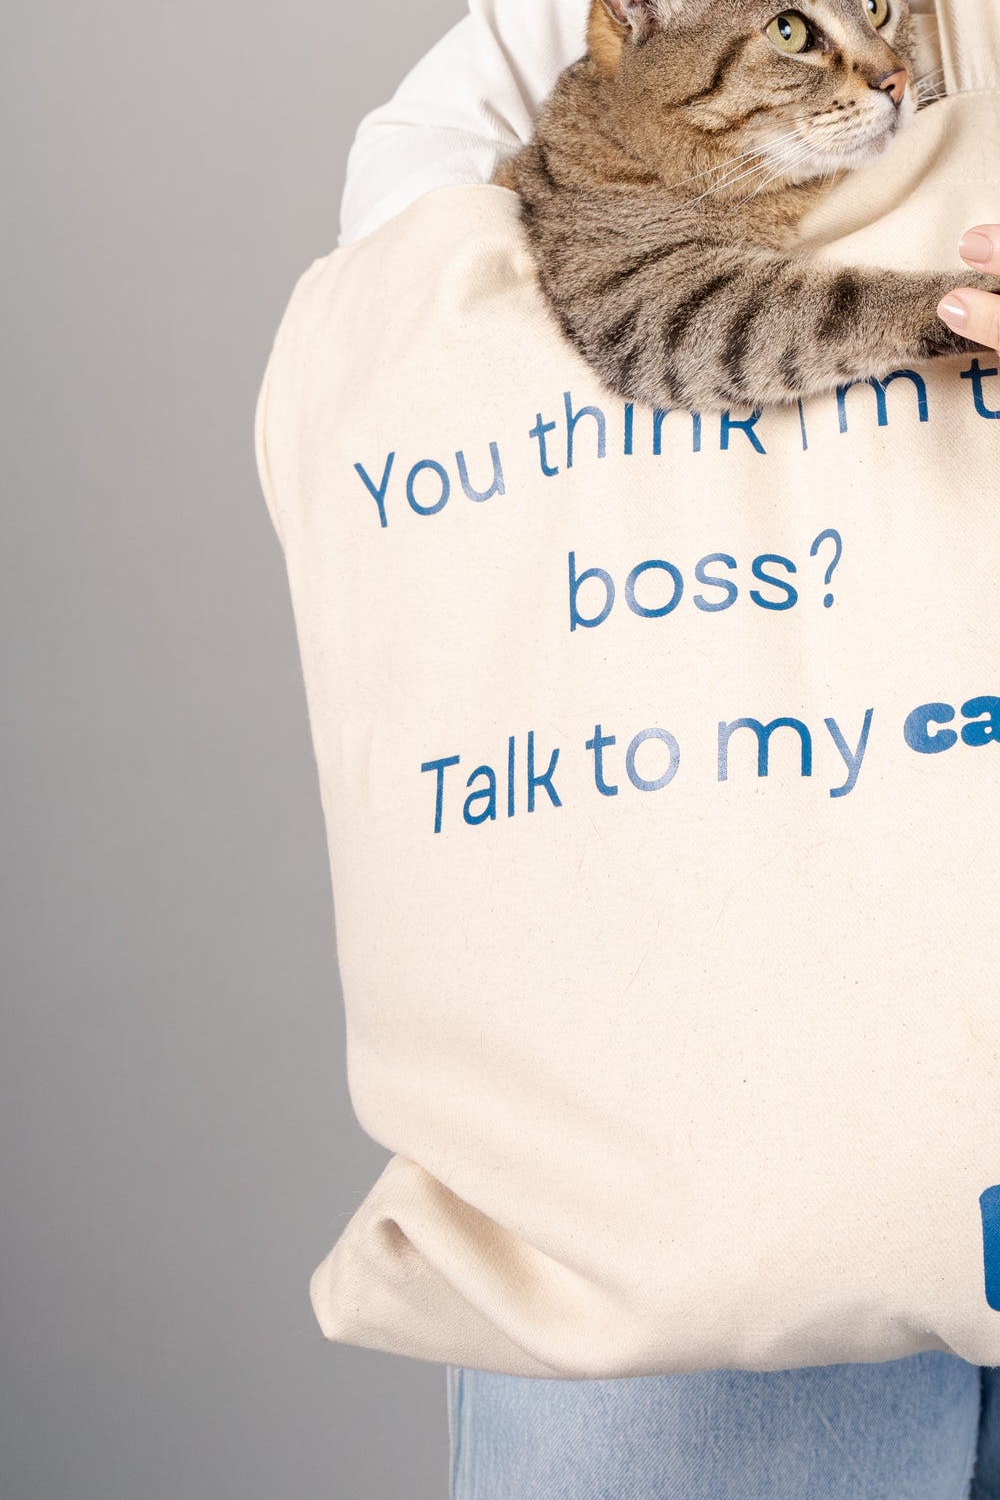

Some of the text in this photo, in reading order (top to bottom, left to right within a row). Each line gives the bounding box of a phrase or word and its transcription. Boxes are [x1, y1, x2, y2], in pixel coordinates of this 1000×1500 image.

[353, 441, 506, 529] You
[796, 368, 930, 451] Im
[567, 528, 844, 632] boss?
[420, 730, 564, 835] Talk
[585, 723, 681, 797] to
[717, 708, 874, 799] my
